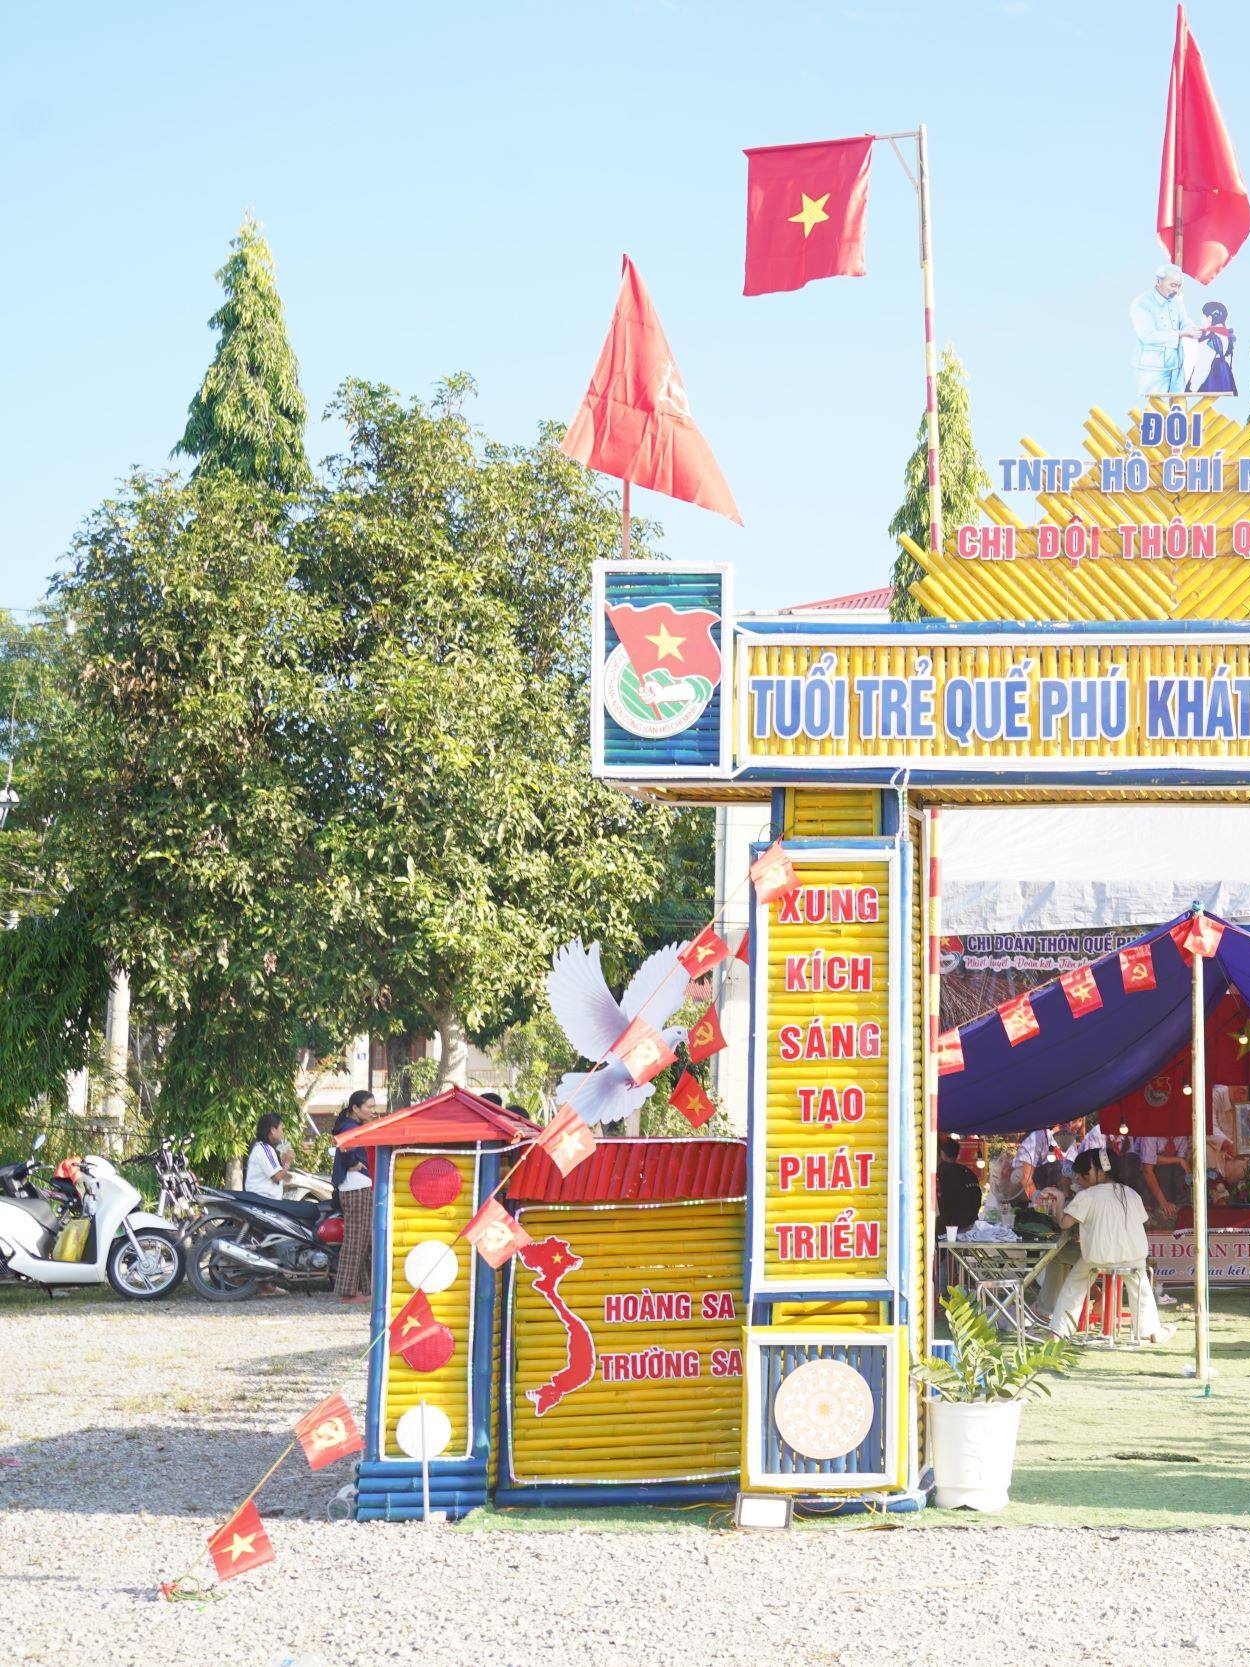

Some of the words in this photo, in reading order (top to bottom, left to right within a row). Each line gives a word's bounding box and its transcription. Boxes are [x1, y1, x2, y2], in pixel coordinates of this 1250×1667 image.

[1140, 405, 1203, 453] ĐỘI
[999, 457, 1083, 492] TNTP
[1102, 440, 1150, 492] HỒ
[1163, 451, 1224, 492] CHÍ
[958, 524, 1016, 560] CHI
[1038, 516, 1100, 566] ĐỘI
[1119, 517, 1216, 559] THÔN
[750, 653, 849, 740] TUỔI
[855, 656, 936, 741] TRẺ
[944, 659, 1032, 748] QUẾ
[1039, 665, 1129, 741] PHÚ
[779, 887, 879, 923] XUNG
[968, 935, 992, 952] CHI
[994, 933, 1036, 953] ĐOÀN
[1039, 933, 1080, 953] THÔN
[1083, 931, 1116, 954] QUẾ
[785, 949, 872, 992] KÍCH
[779, 1018, 881, 1061] SÁNG
[797, 1086, 865, 1130] TẠO
[779, 1146, 875, 1191] PHÁT
[775, 1207, 880, 1260] TRIỂN
[1149, 1243, 1165, 1258] HI
[605, 1288, 691, 1323] HOÀNG
[702, 1292, 735, 1320] SA
[600, 1345, 699, 1381] TRƯỜNG
[711, 1349, 743, 1377] SA
